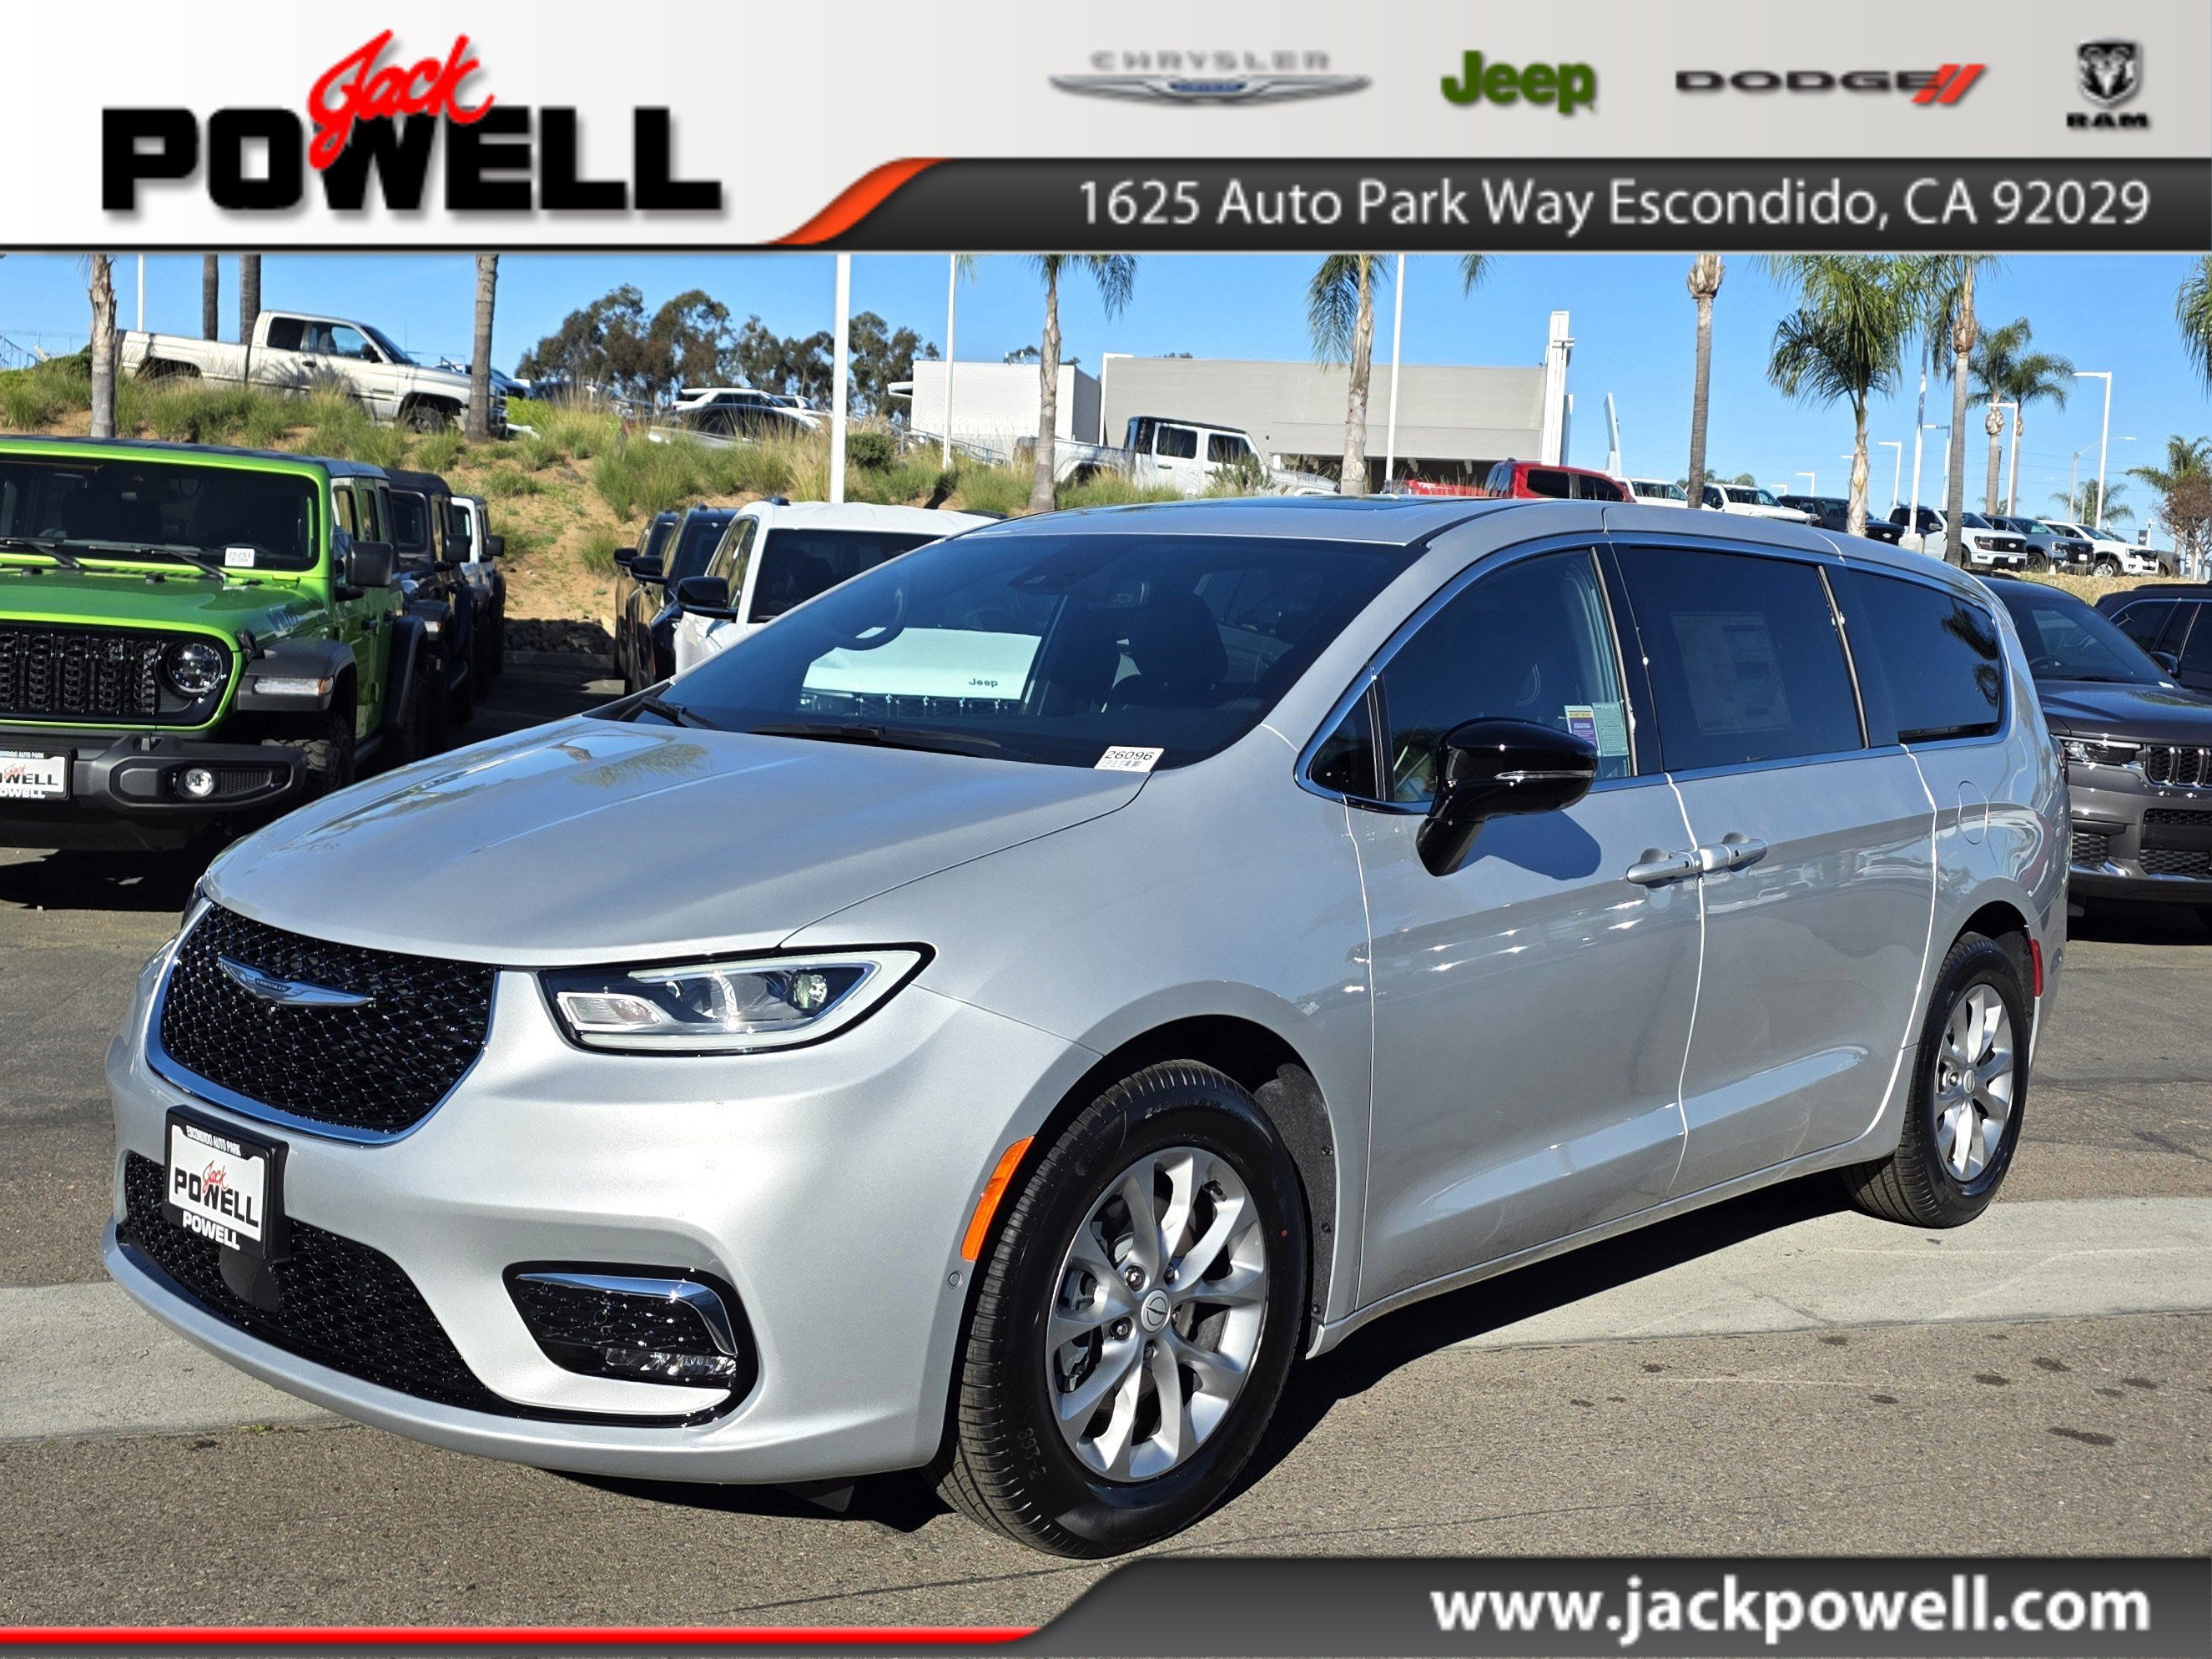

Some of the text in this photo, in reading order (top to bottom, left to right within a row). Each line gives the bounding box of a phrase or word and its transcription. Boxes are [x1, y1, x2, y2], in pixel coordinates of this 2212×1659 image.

[968, 678, 998, 688] Jeep
[1105, 750, 1155, 760] 26096
[0, 773, 59, 786] WELL
[213, 1135, 227, 1152] AUTO
[226, 1140, 242, 1157] PARK
[202, 1159, 229, 1195] Jack
[174, 1167, 259, 1228] POWELL
[182, 1210, 241, 1251] POWELL
